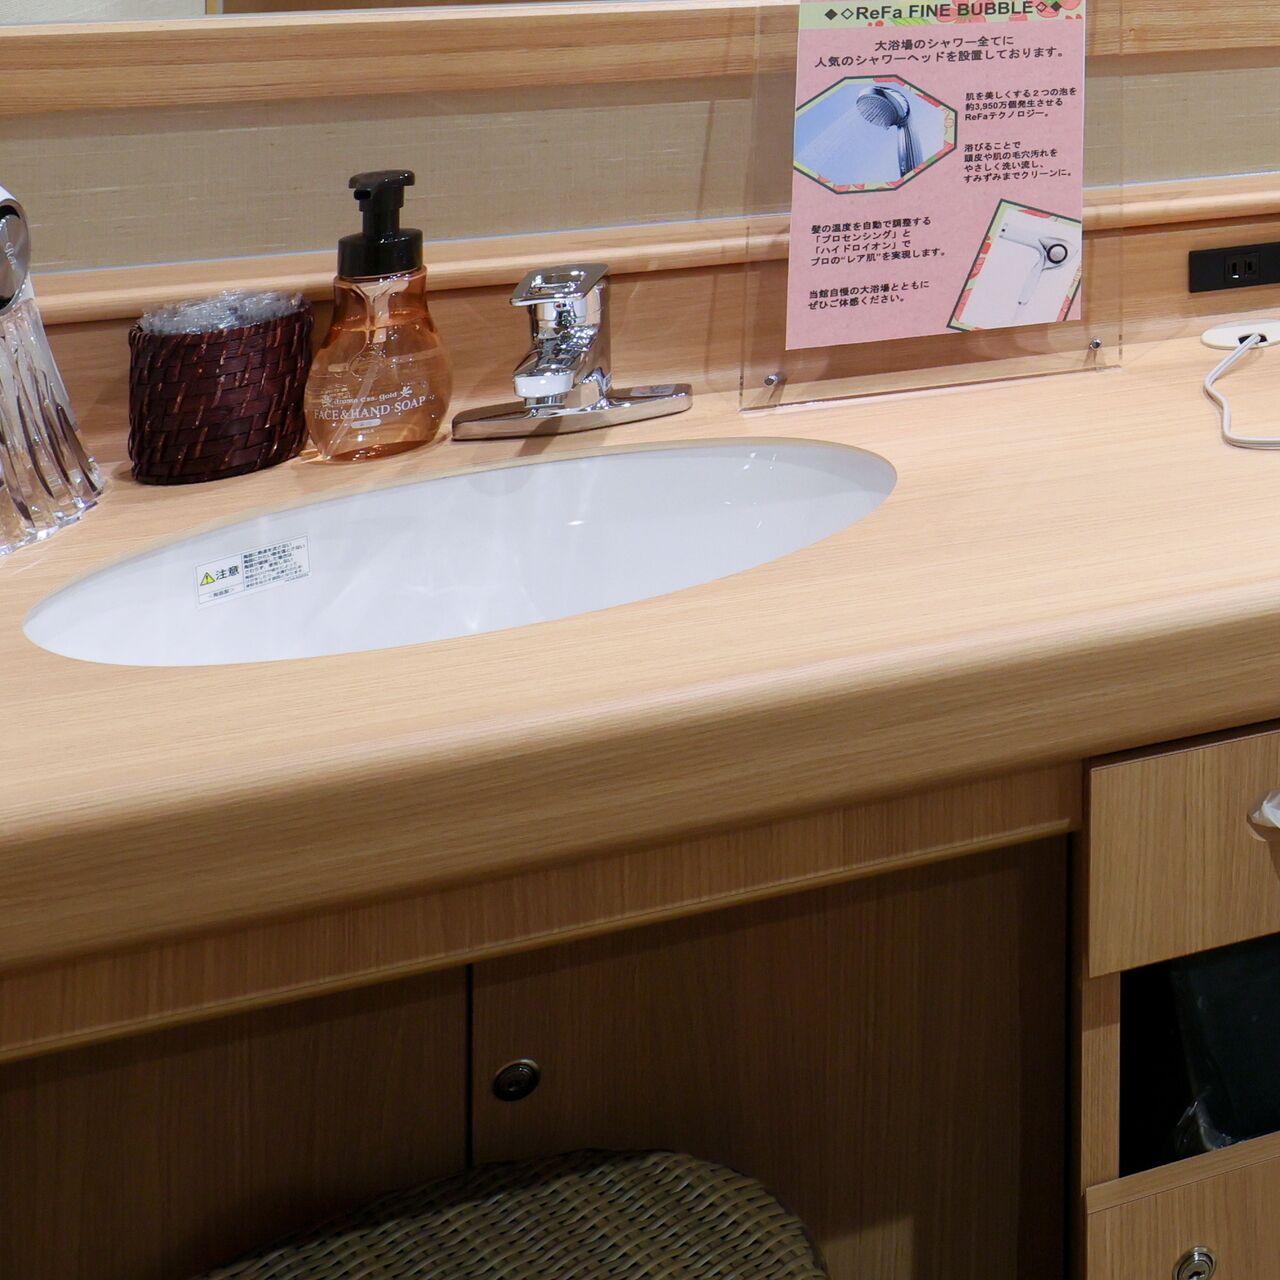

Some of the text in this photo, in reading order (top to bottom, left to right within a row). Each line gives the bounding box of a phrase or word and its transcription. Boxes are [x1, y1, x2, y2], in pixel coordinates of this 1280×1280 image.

[856, 0, 1033, 20] ReFa FINE BUBBLE
[875, 35, 1014, 51] 大浴場のシャワー全てに
[814, 48, 1064, 68] 人気のシャワーヘッドを設置しております。
[965, 109, 1049, 121] ReFaテクノロジー。
[964, 141, 1021, 152] 浴びることで
[963, 168, 1072, 184] すみずみまでクリーンに。
[816, 229, 911, 244] 「プロセンシング」と
[815, 240, 911, 255] 「ハイドロイオン」で
[809, 280, 930, 299] 当館自慢の大浴場とともに
[808, 293, 905, 311] ぜひご体感ください。
[394, 396, 426, 412] SOAP
[215, 565, 240, 581] 注意
